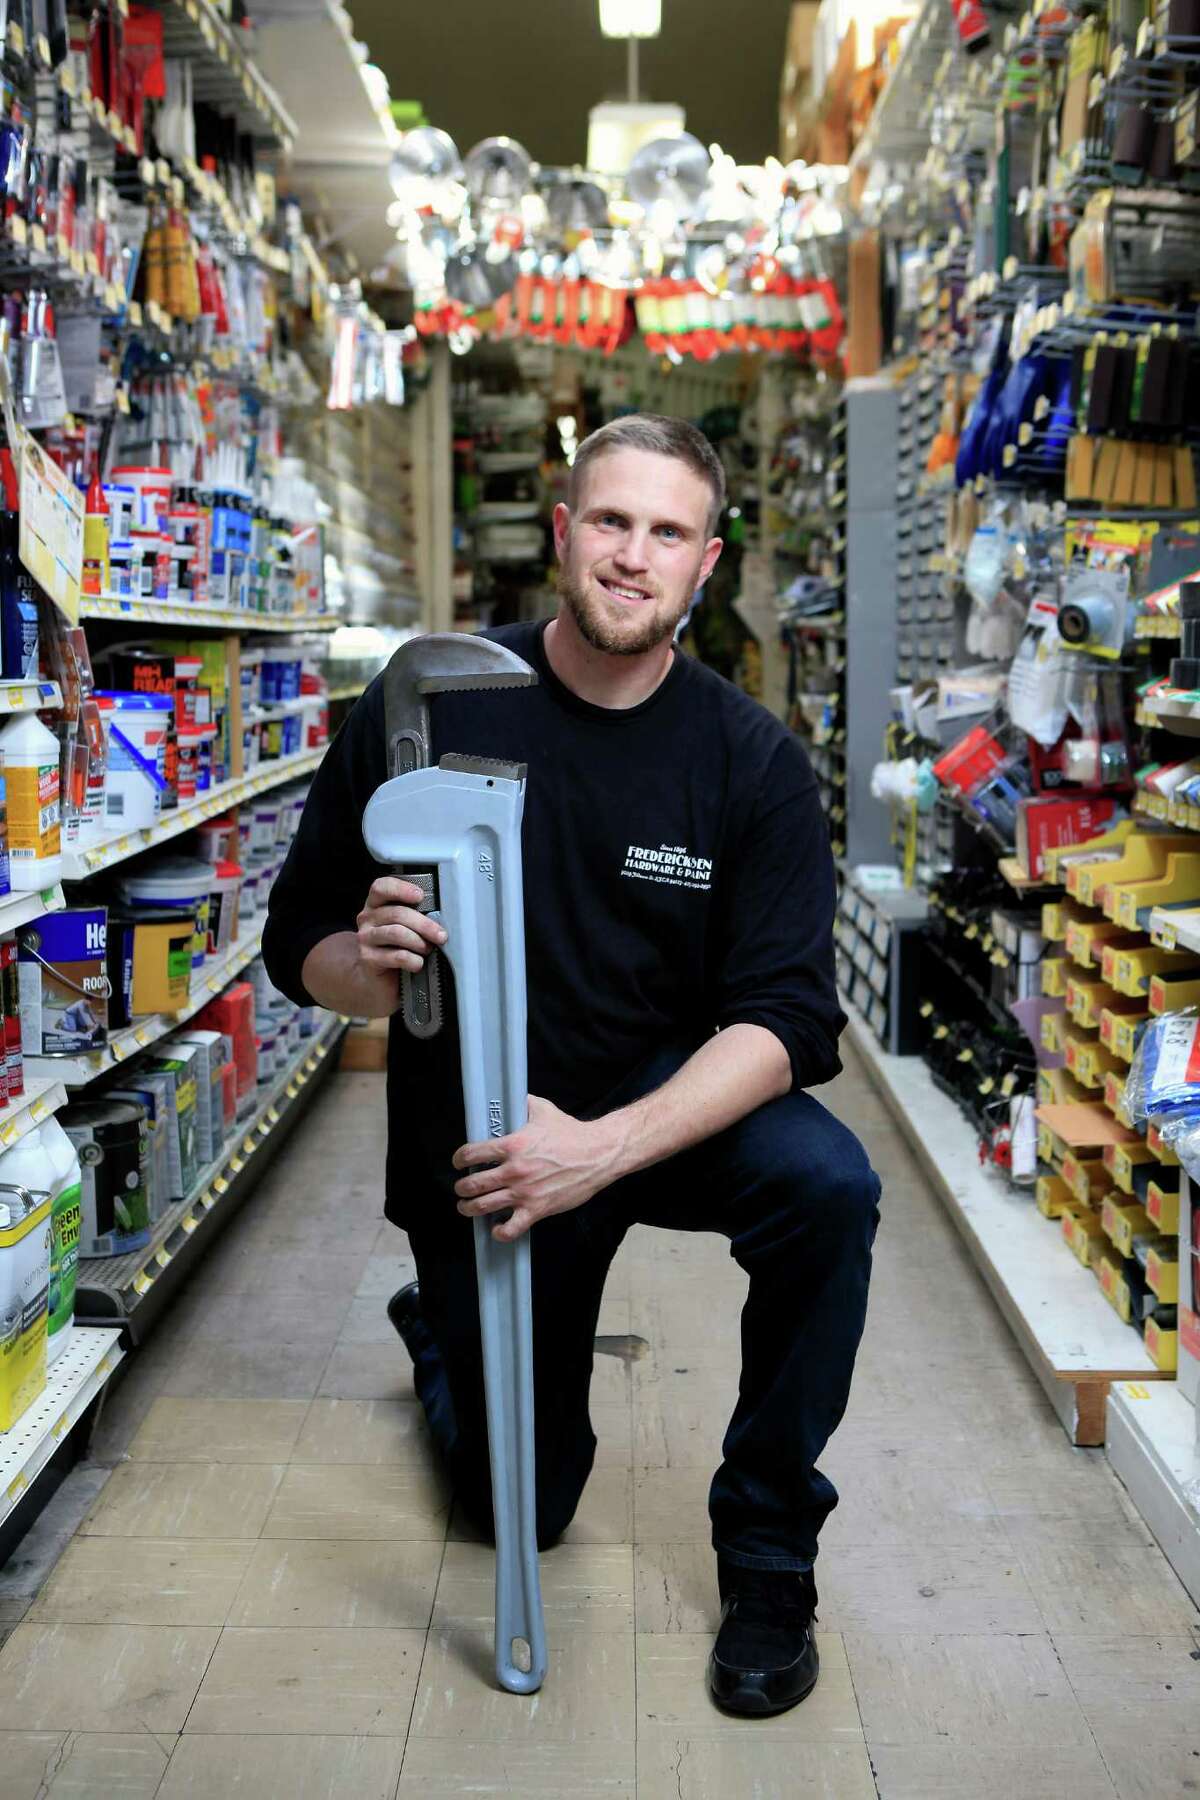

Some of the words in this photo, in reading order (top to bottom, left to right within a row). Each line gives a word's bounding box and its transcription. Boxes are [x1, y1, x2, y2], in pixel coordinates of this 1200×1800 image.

[625, 858, 675, 875] HARDWARE
[677, 868, 684, 876] &
[684, 868, 711, 880] PAINT
[627, 846, 712, 870] FREDERICKSEN
[489, 1100, 502, 1137] HEAV
